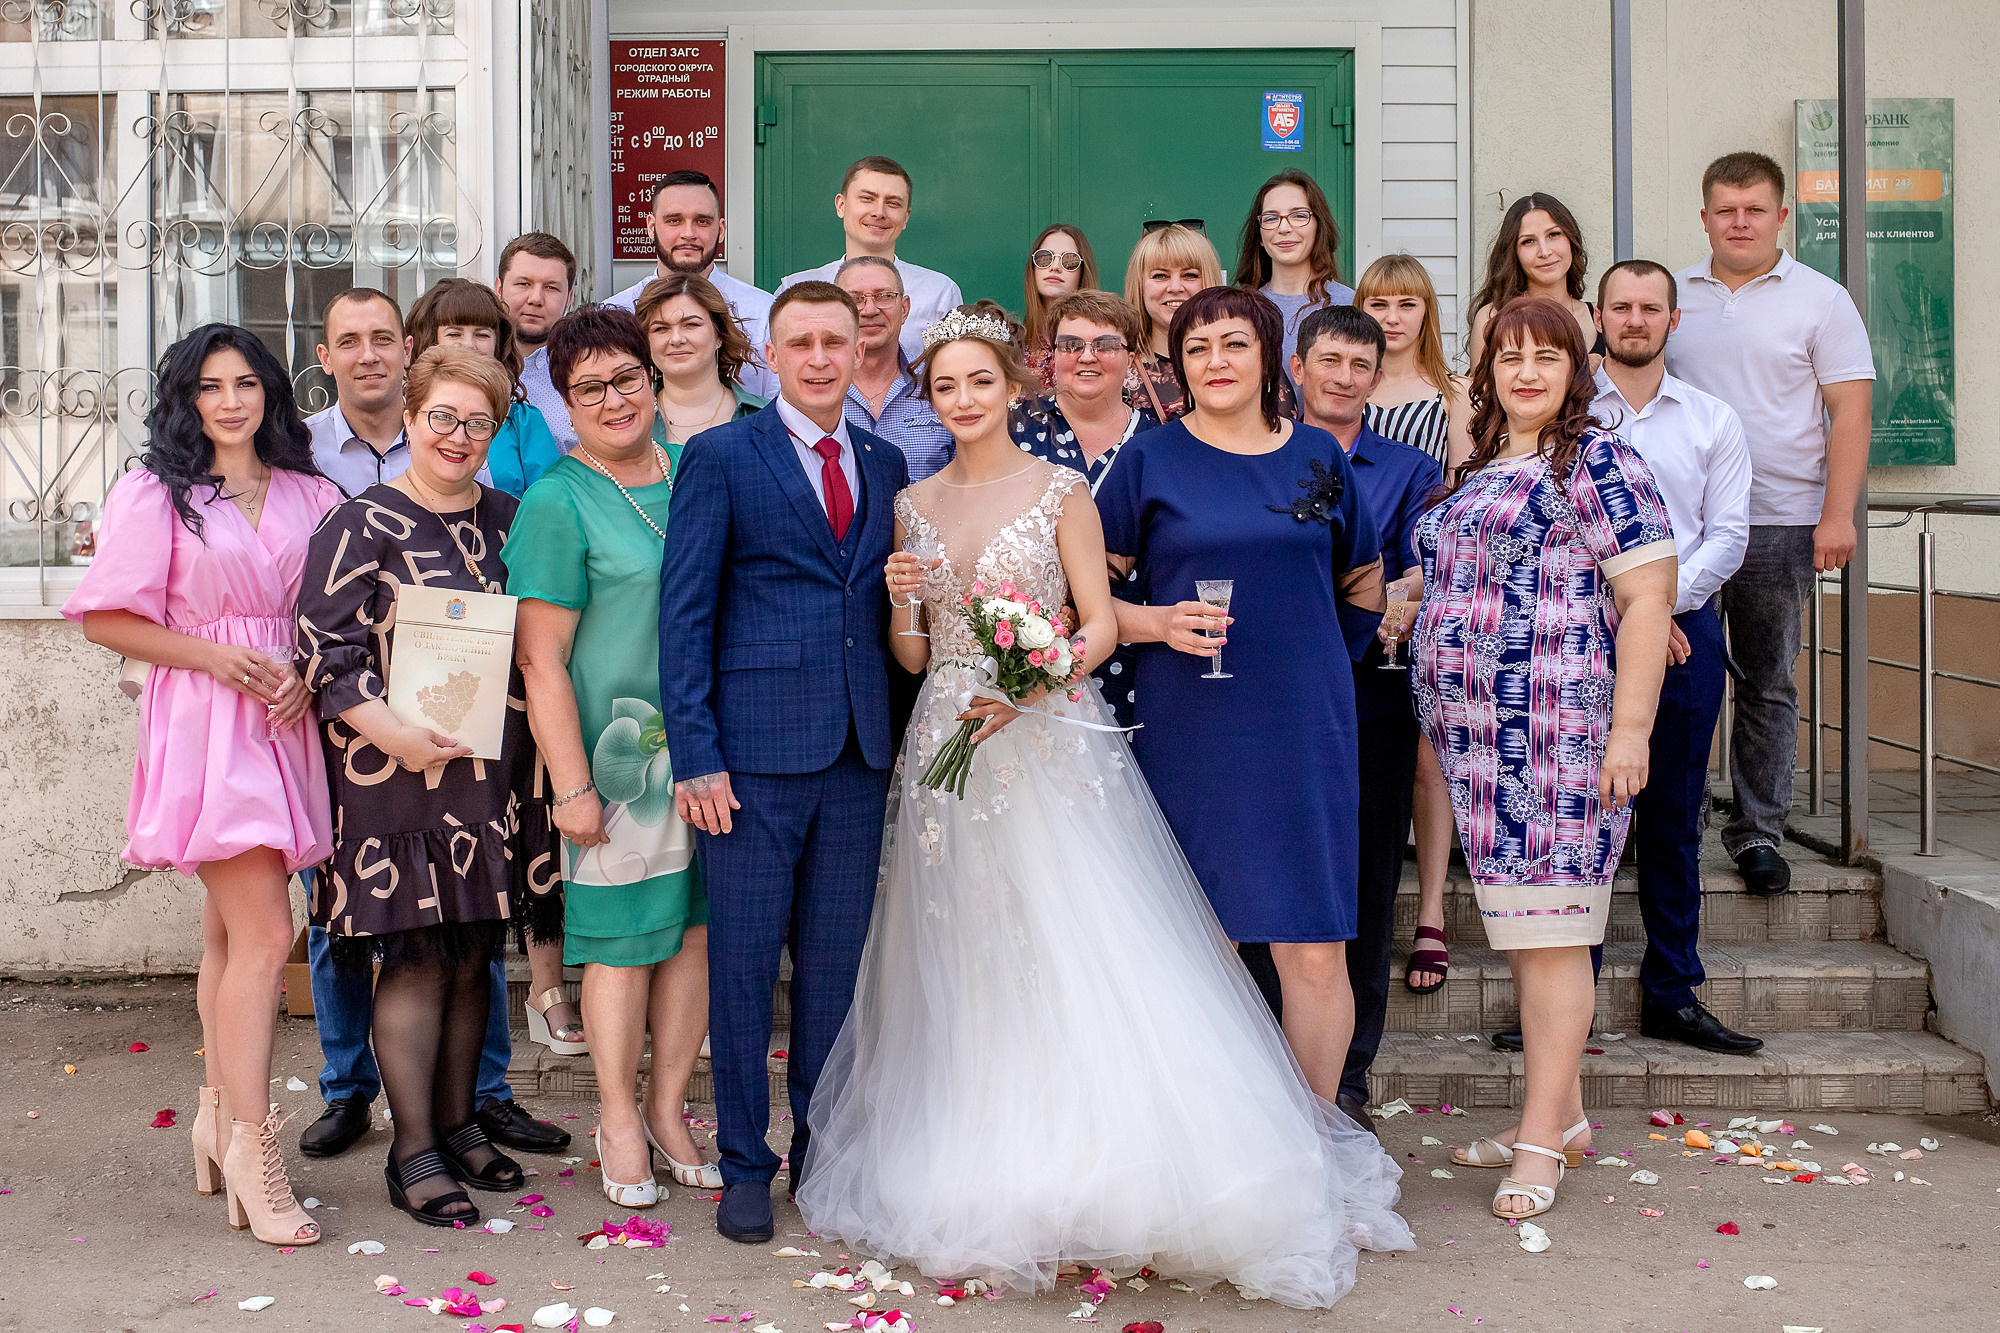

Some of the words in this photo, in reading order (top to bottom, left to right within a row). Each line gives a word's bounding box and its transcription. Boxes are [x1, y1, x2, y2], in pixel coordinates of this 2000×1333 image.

[628, 48, 667, 58] ОТДЕЛ
[670, 48, 700, 57] ЗАГС
[614, 64, 677, 73] ГОРОДСКОГО
[678, 64, 714, 72] ОКРУГА
[638, 74, 690, 84] ОТРАДНЫЙ
[616, 89, 659, 98] РЕЖИМ
[662, 89, 711, 98] РАБОТЫ
[1273, 113, 1295, 127] АБ
[1816, 231, 1837, 241] для
[437, 654, 467, 663] БРАКА
